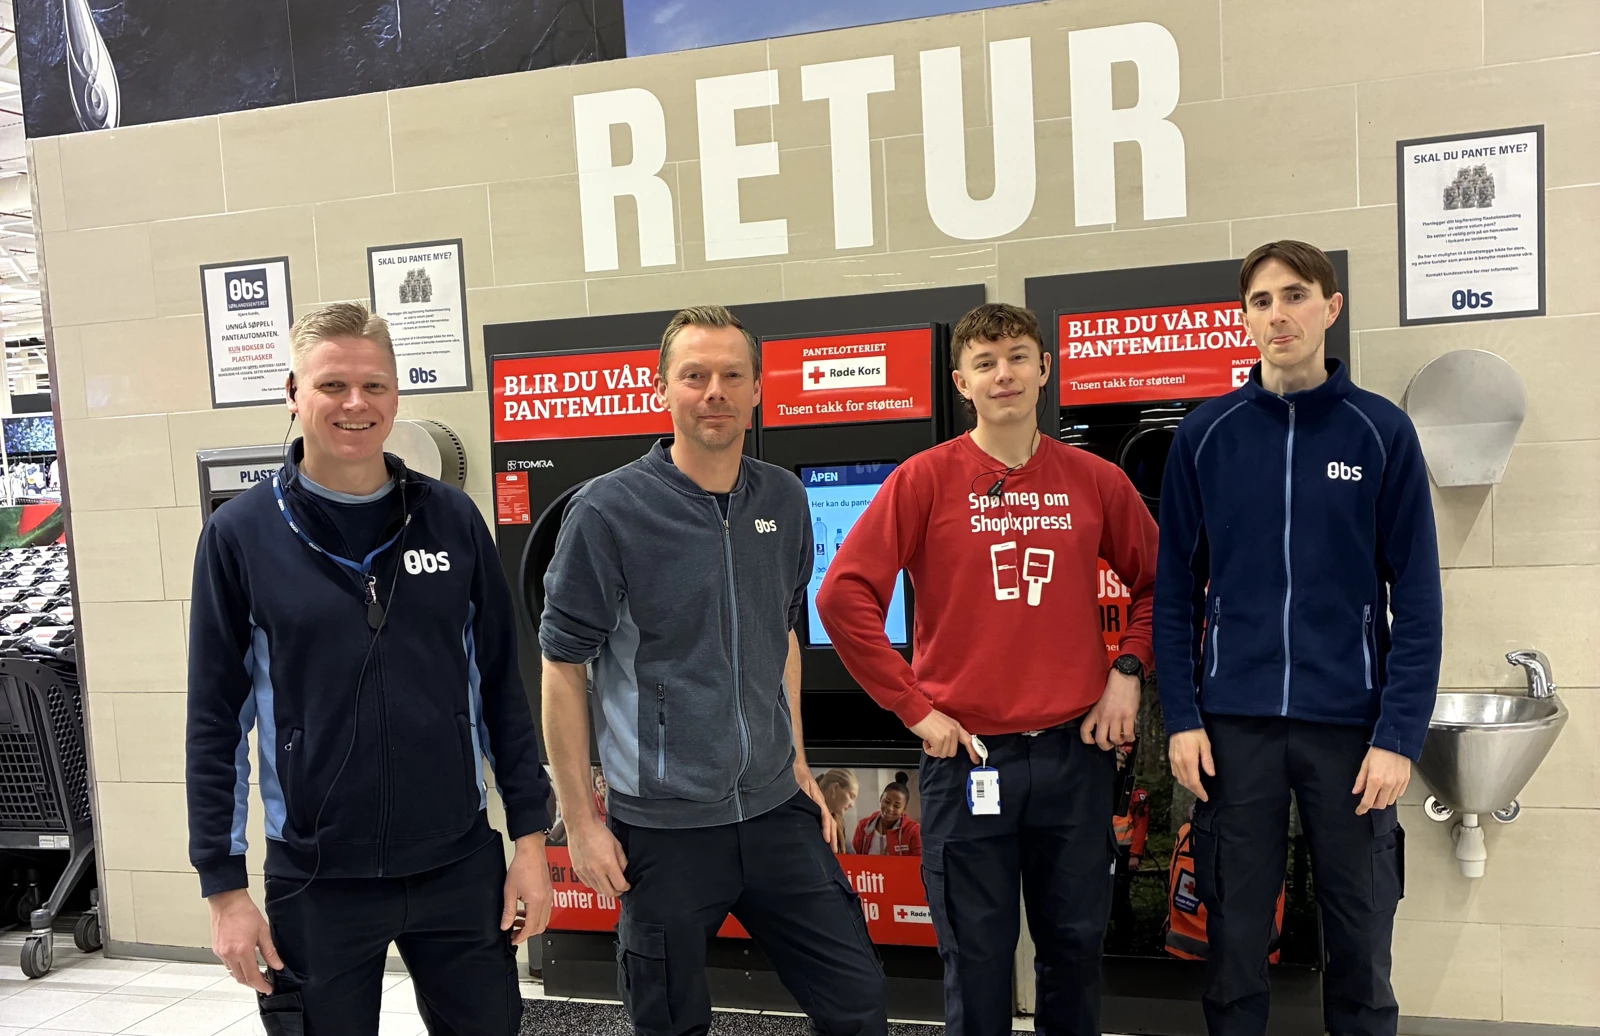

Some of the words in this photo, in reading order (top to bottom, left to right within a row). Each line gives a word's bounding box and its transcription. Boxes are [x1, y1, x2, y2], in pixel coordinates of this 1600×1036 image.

[574, 22, 1187, 272] RETUR
[1414, 153, 1440, 164] SKAL
[1444, 151, 1458, 161] DU
[1462, 147, 1496, 159] PANTE
[1499, 143, 1528, 155] MYE?
[378, 258, 396, 266] SKAL
[398, 256, 407, 264] DU
[409, 254, 432, 263] PANTE
[433, 252, 452, 260] MYE?
[226, 321, 247, 331] UNNGÅ
[248, 320, 270, 329] SØPPEL
[1068, 318, 1120, 338] BLIR
[1124, 315, 1157, 334] DU
[1162, 309, 1209, 331] VÅR
[222, 331, 280, 342] PANTEAUTOMATEN.
[242, 344, 264, 352] BOKSER
[803, 343, 886, 357] PANTELOTTERIET
[232, 354, 273, 363] PLASTFLASKER
[504, 374, 558, 396] BLIR
[563, 371, 598, 393] DU
[603, 364, 653, 390] VÅR
[830, 367, 855, 378] Røde
[858, 366, 881, 376] Kors
[1070, 380, 1101, 391] Tusen
[1103, 378, 1126, 389] takk
[1128, 377, 1144, 387] for
[1146, 375, 1186, 386] støtten!
[504, 392, 671, 422] PANTEMILLIO
[778, 403, 813, 416] Tusen
[816, 401, 843, 413] takk
[846, 400, 865, 412] for
[866, 397, 913, 411] støtten!
[517, 460, 554, 469] TOMRA
[810, 470, 838, 483] ÅPEN
[1004, 492, 1040, 510] meg
[1044, 493, 1069, 506] om
[857, 871, 885, 893] ditt
[551, 889, 593, 909] tøtter
[861, 898, 880, 923] jø
